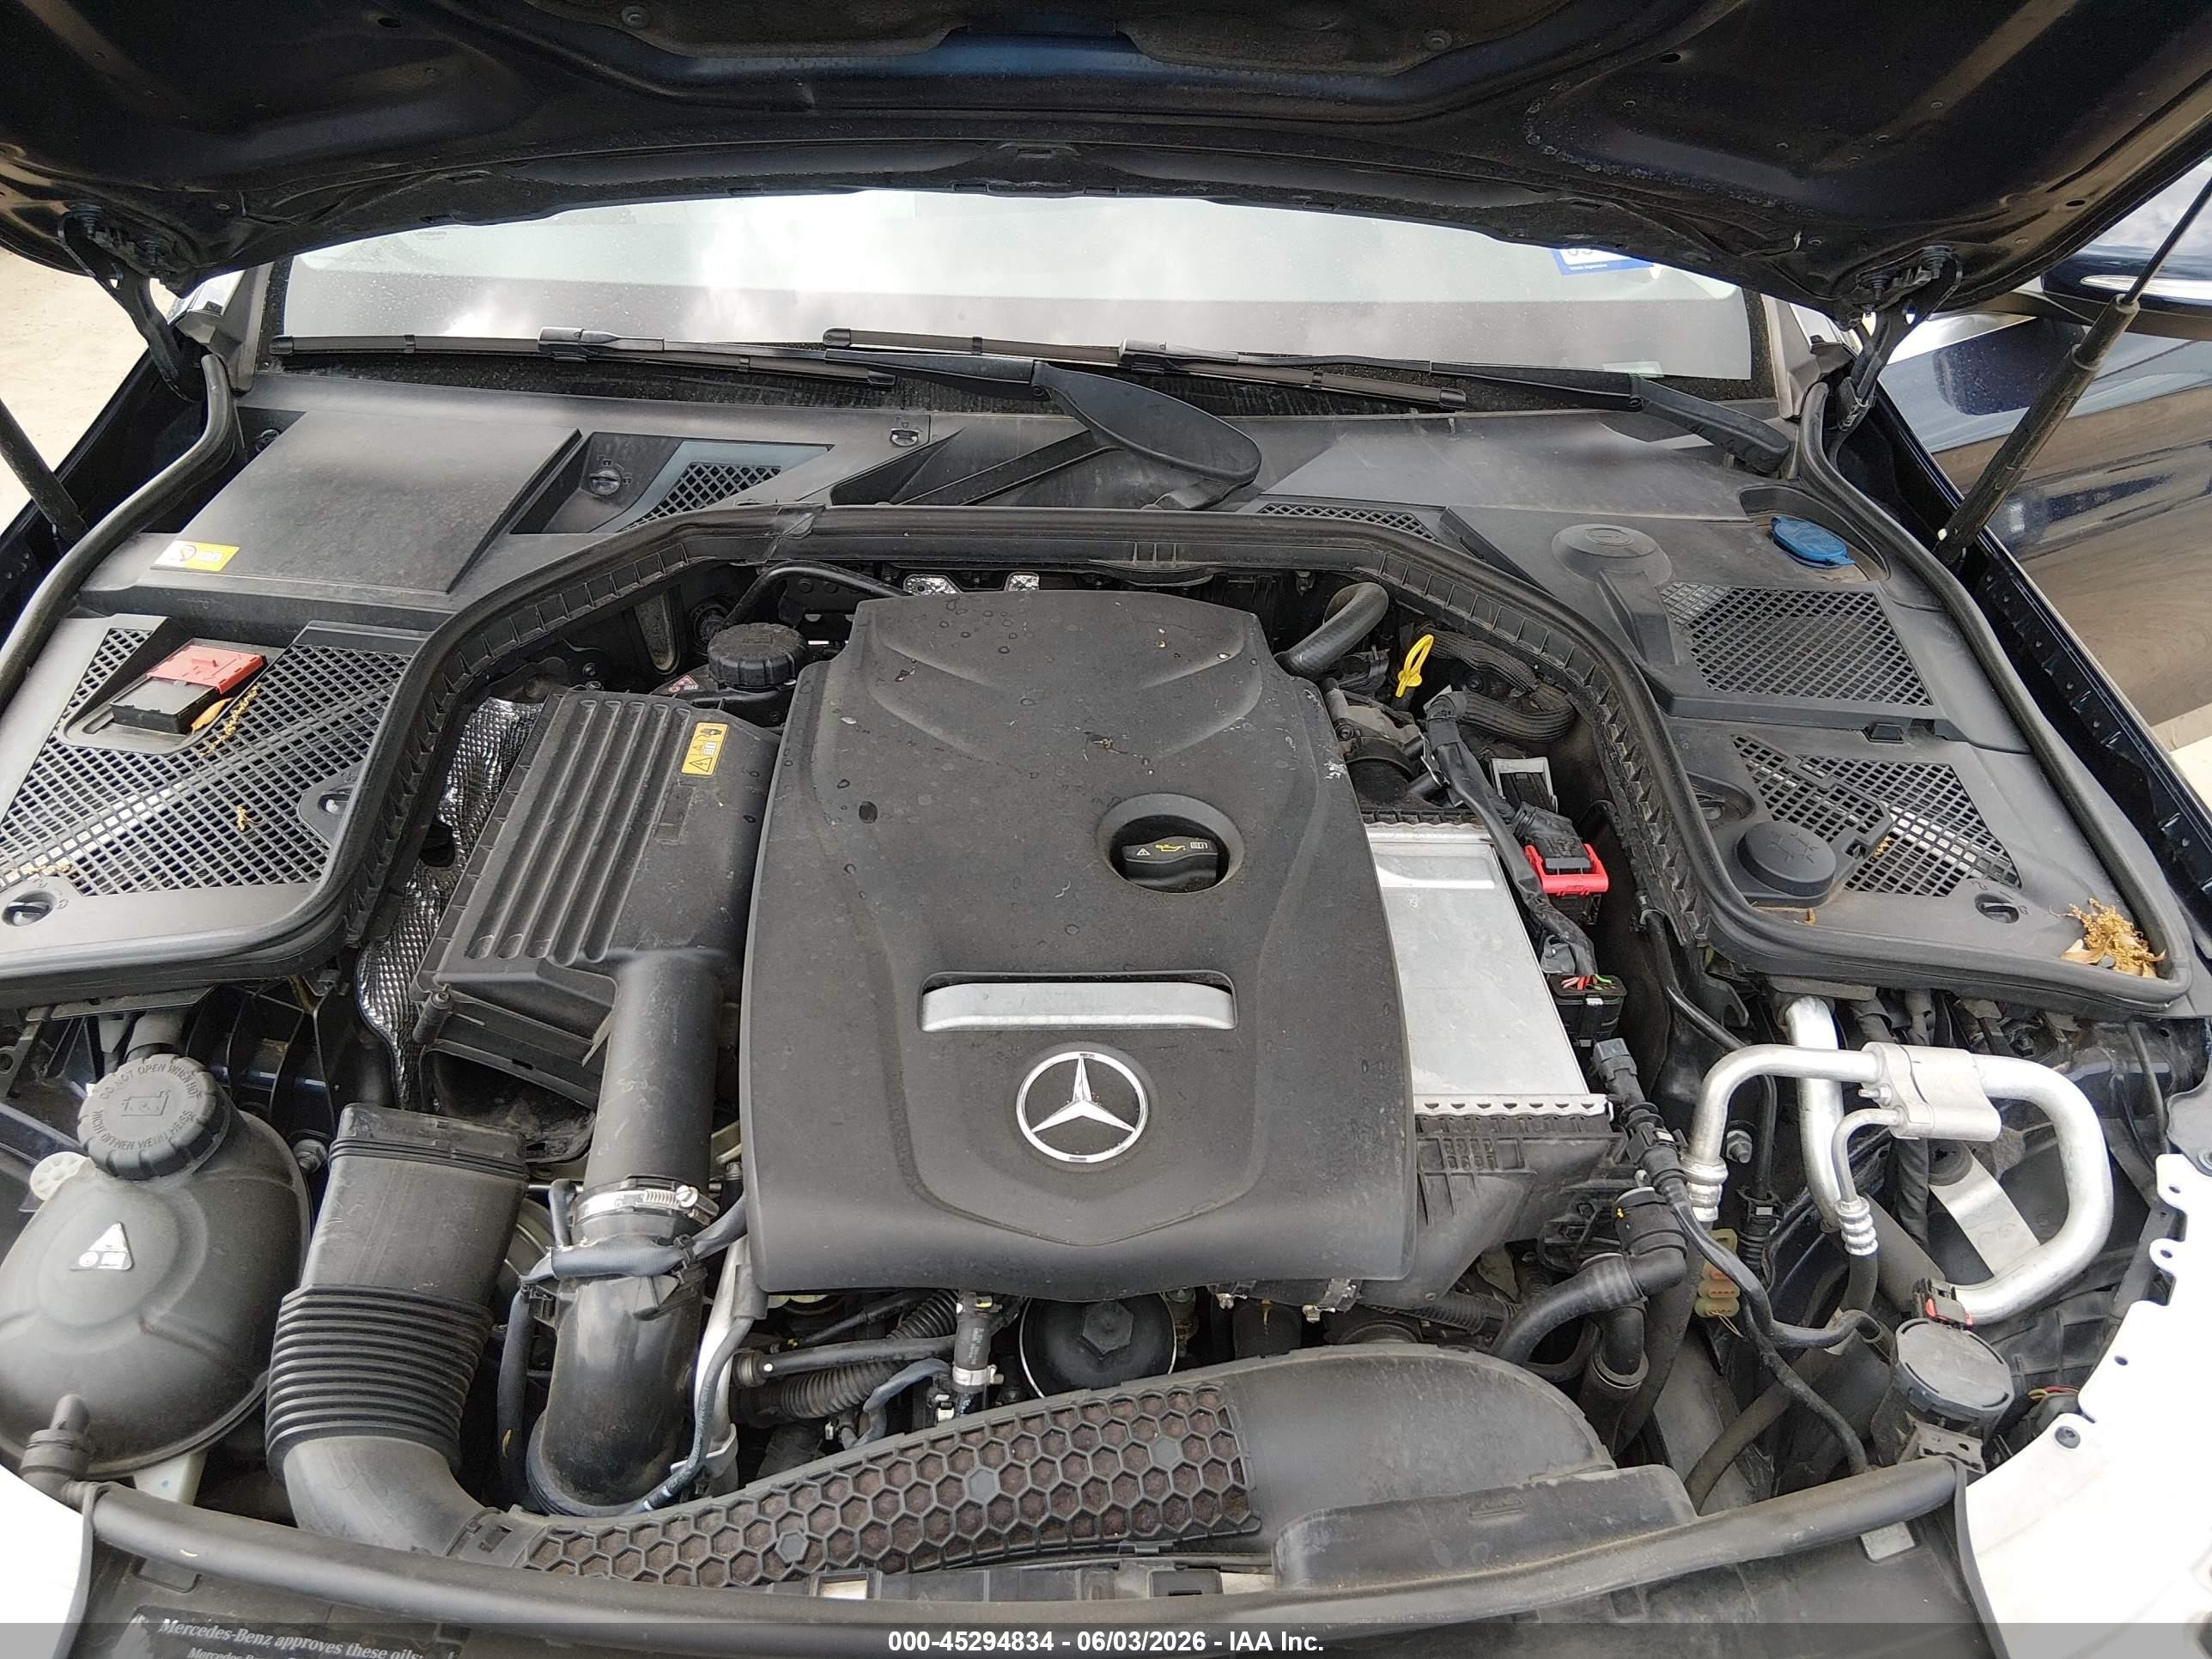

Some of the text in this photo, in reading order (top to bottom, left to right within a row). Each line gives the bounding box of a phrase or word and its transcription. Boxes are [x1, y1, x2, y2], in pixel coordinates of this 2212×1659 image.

[99, 1064, 201, 1100] DO NOT OPEN WHEN HOT
[158, 1618, 273, 1645] Mercedes-Benz
[273, 1635, 343, 1656] approves
[344, 1642, 388, 1659] these
